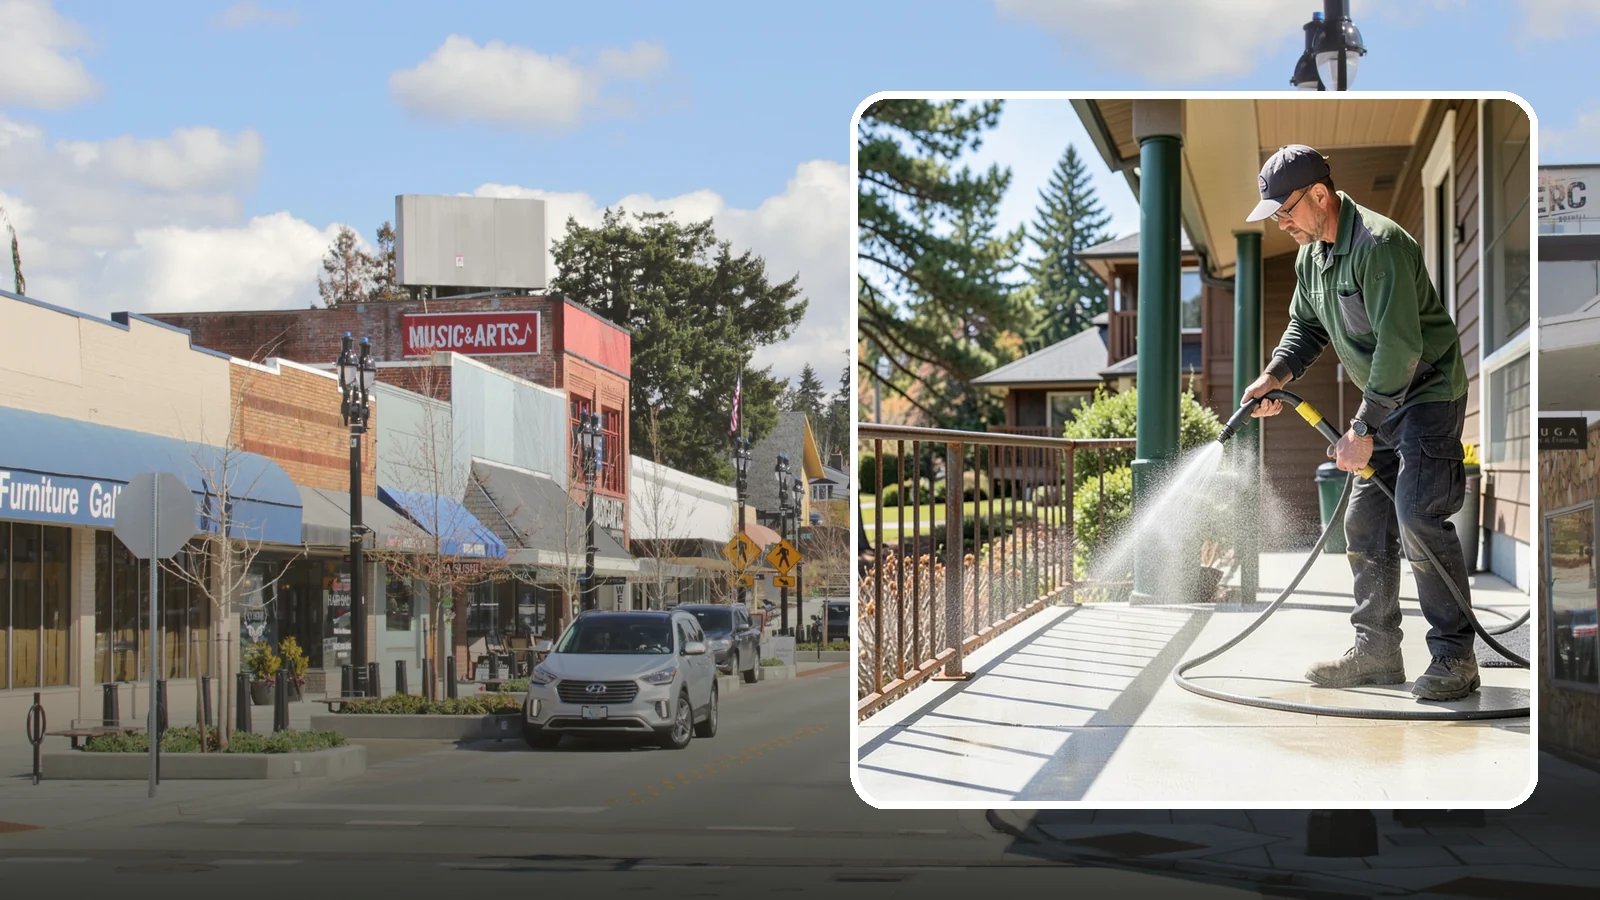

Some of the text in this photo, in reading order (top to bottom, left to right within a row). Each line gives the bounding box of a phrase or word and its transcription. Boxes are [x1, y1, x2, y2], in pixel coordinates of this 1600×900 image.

[409, 323, 519, 349] MUSIC&ARTS
[0, 471, 121, 519] Furniture Gal
[453, 563, 479, 574] SUSHI
